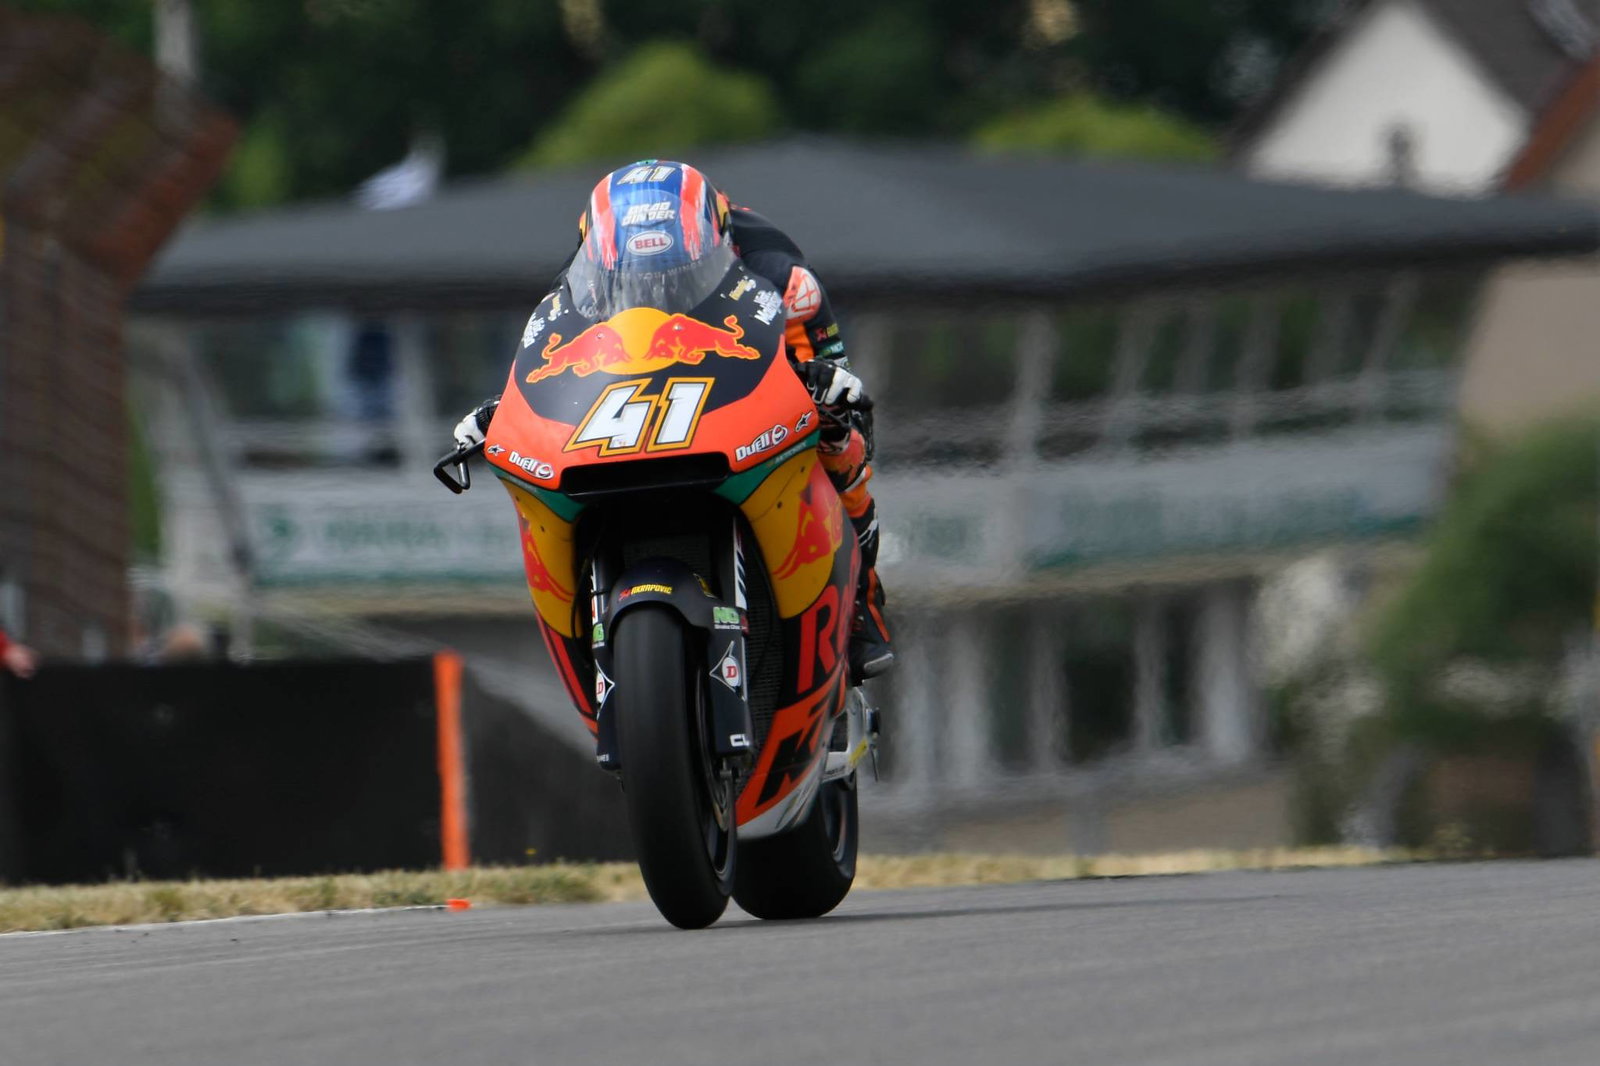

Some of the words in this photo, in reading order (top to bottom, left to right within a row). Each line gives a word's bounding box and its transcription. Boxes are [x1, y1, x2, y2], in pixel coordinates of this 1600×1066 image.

[617, 166, 676, 185] 41
[635, 237, 667, 249] BELL
[563, 377, 715, 457] 41
[726, 666, 737, 678] D
